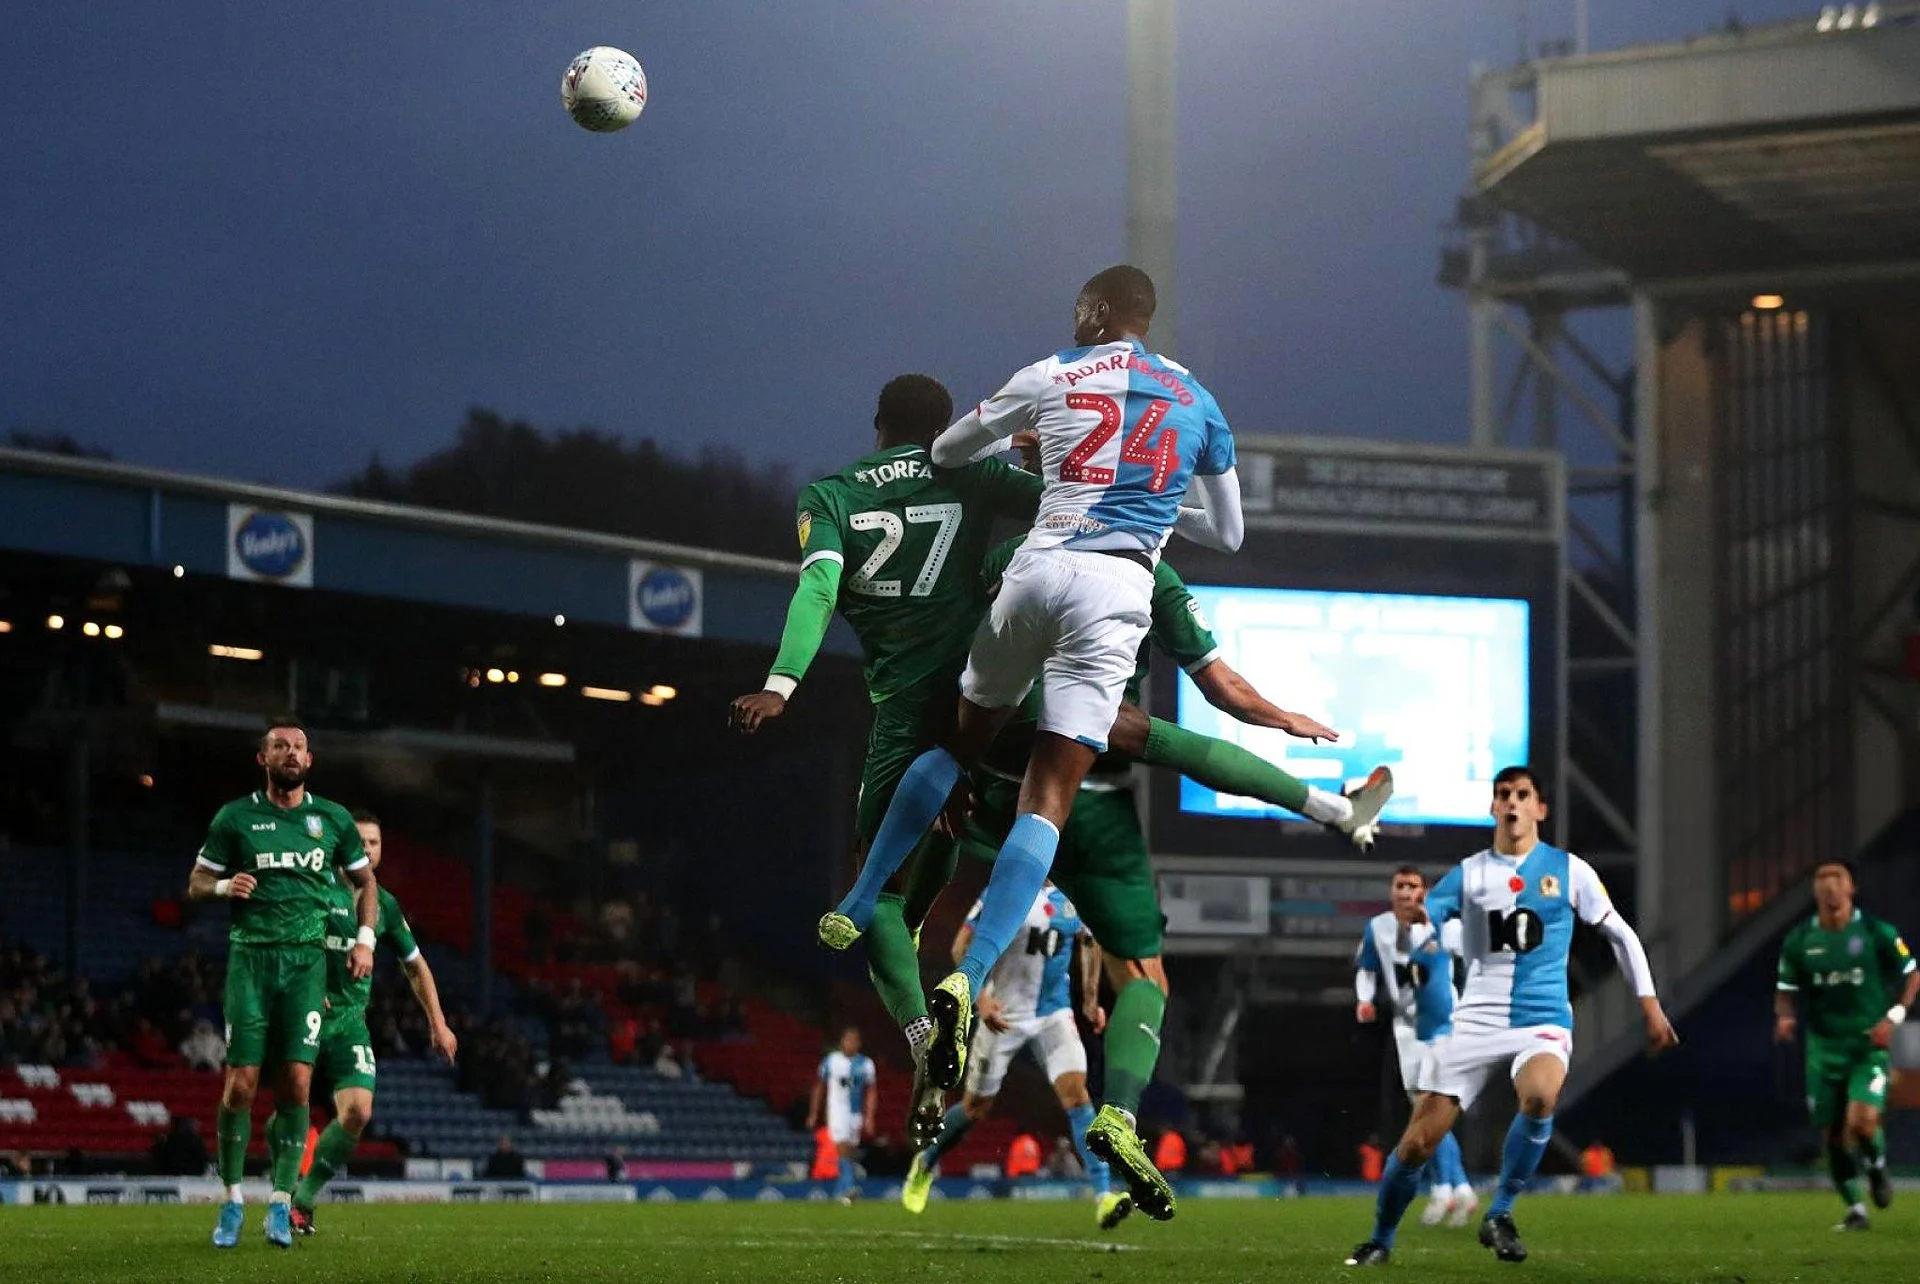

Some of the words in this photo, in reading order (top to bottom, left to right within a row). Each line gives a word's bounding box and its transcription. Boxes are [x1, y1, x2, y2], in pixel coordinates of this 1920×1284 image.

[1059, 392, 1180, 494] 24
[848, 503, 962, 596] 27
[256, 847, 325, 872] ELEV8
[306, 1011, 321, 1041] 9
